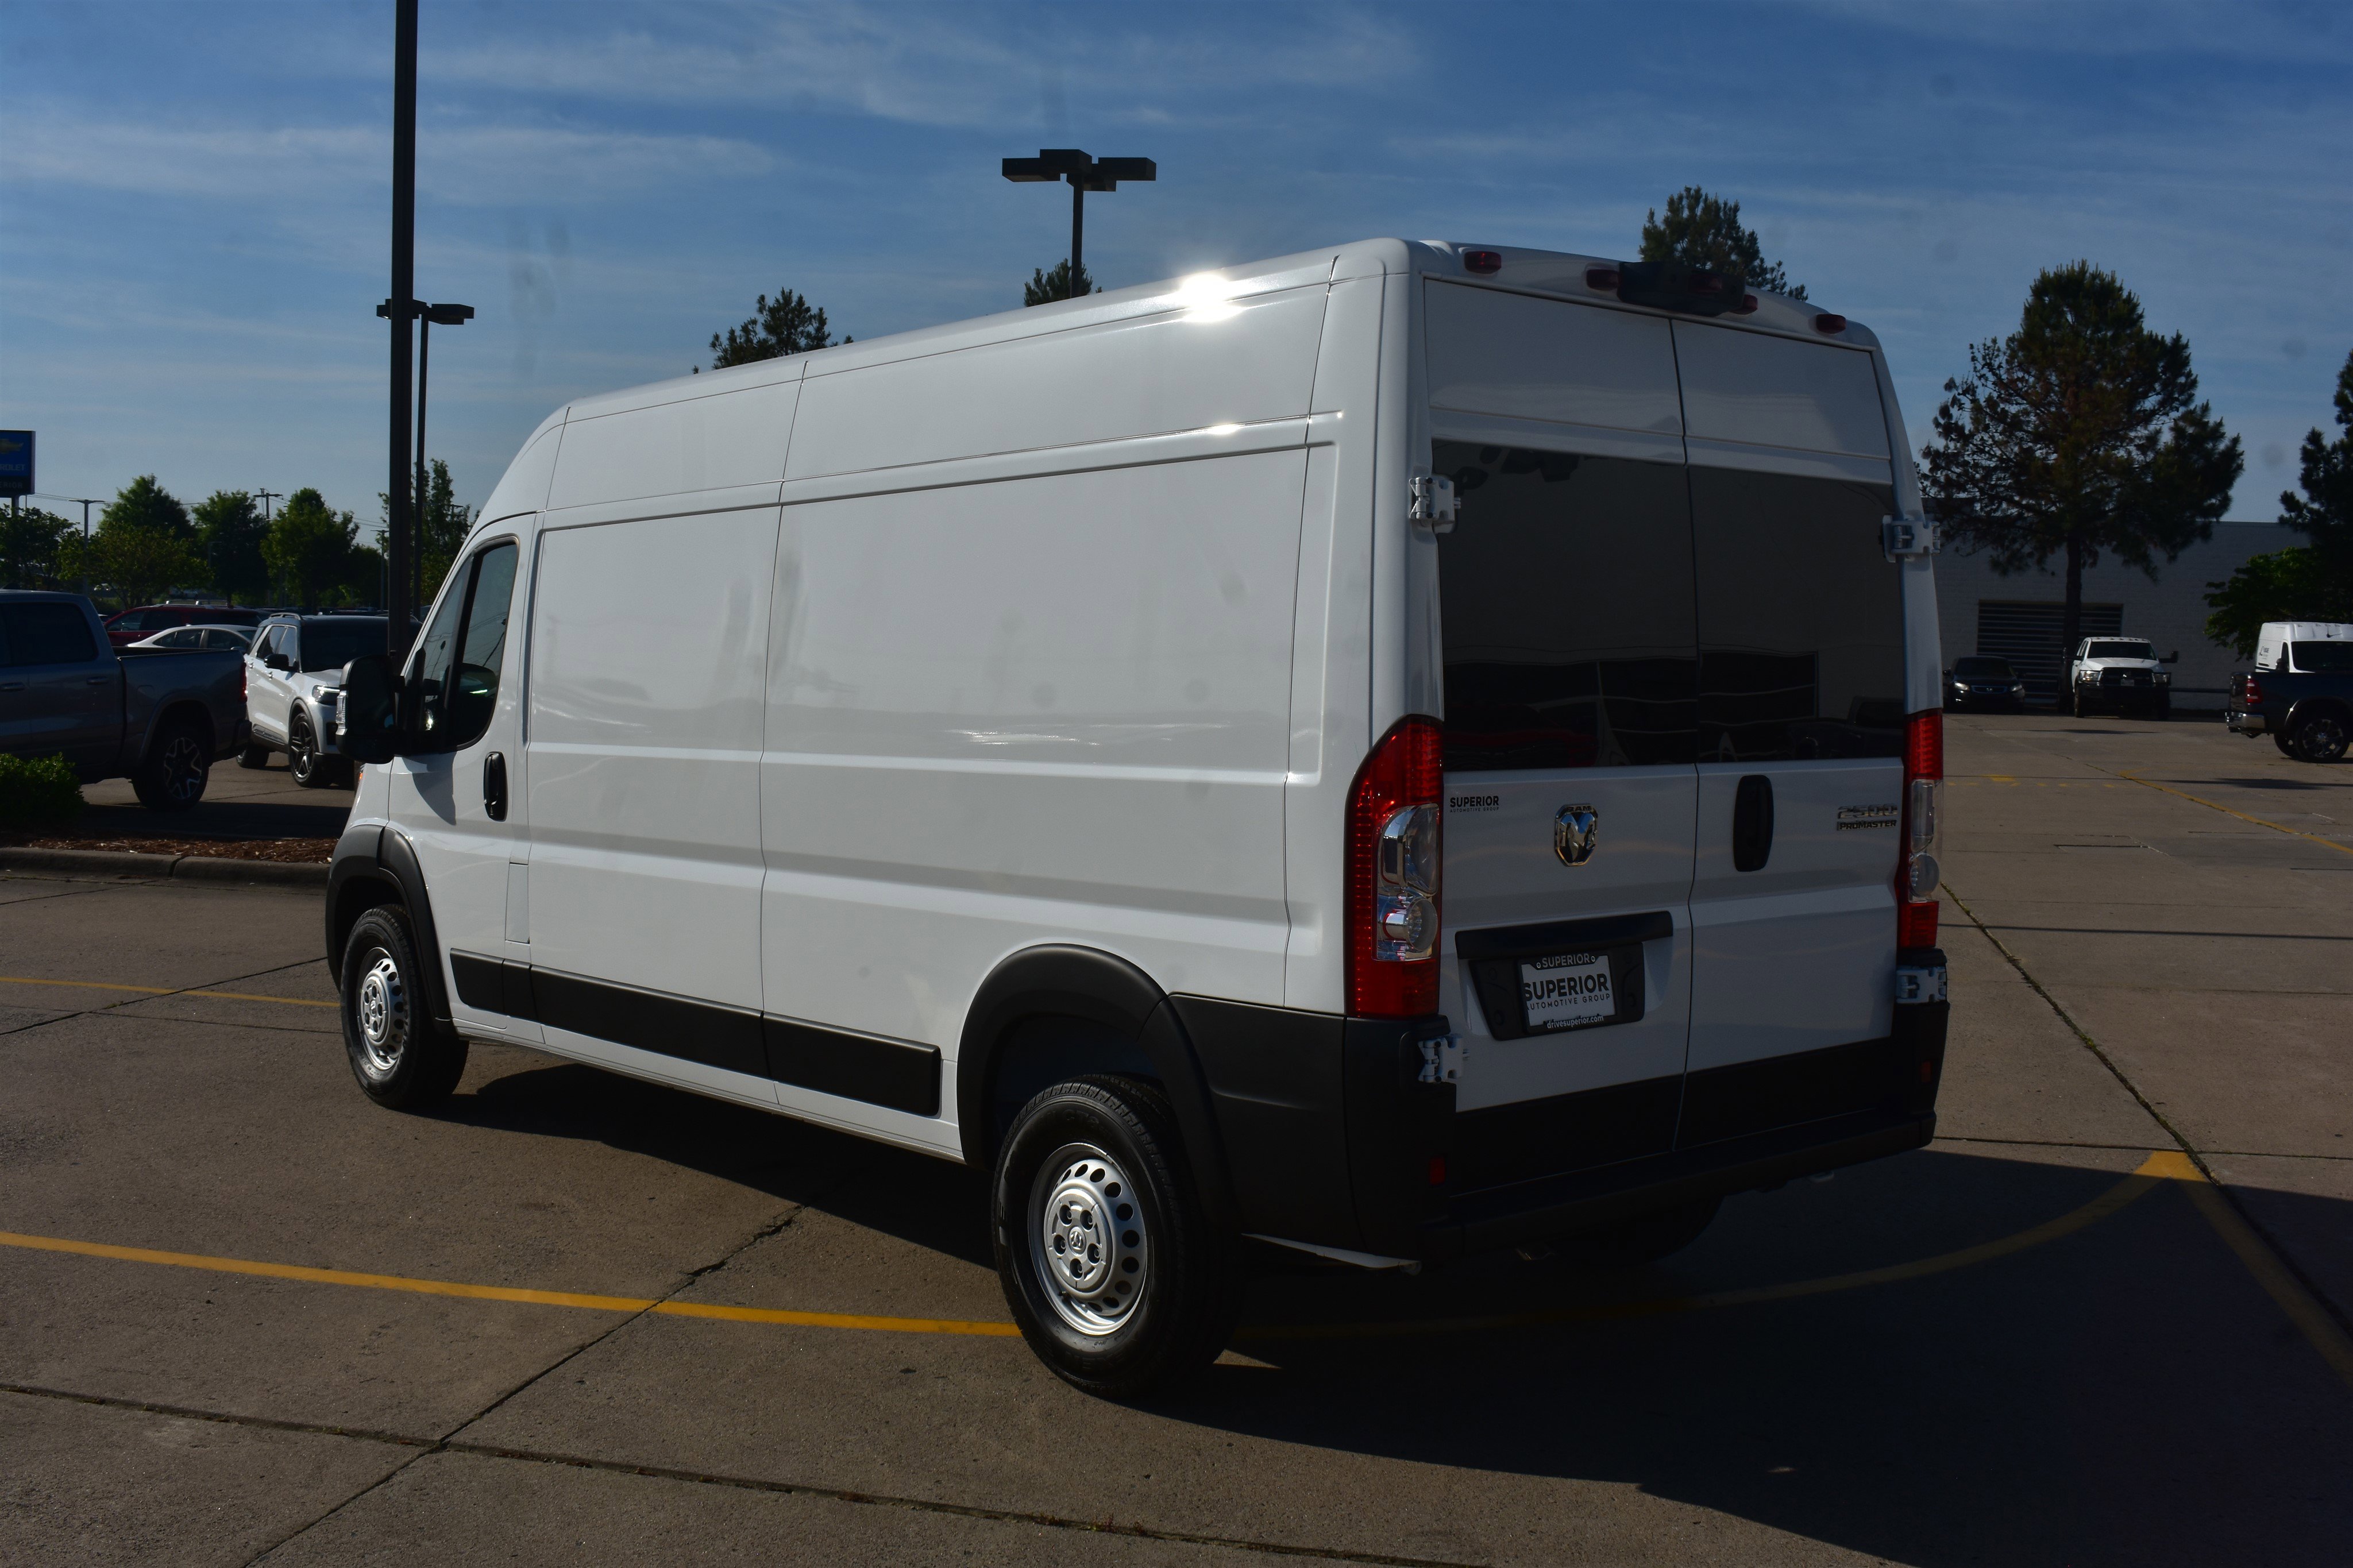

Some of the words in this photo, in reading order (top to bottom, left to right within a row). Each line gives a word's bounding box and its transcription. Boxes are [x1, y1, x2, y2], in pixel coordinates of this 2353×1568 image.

[1450, 795, 1499, 808] SUPERIOR
[1838, 804, 1897, 818] 2500
[1541, 953, 1591, 968] SUPERIOR
[1523, 973, 1609, 1001] SUPERIOR
[1583, 993, 1610, 1003] GROUP
[1546, 1015, 1604, 1029] drivesuperior.com
